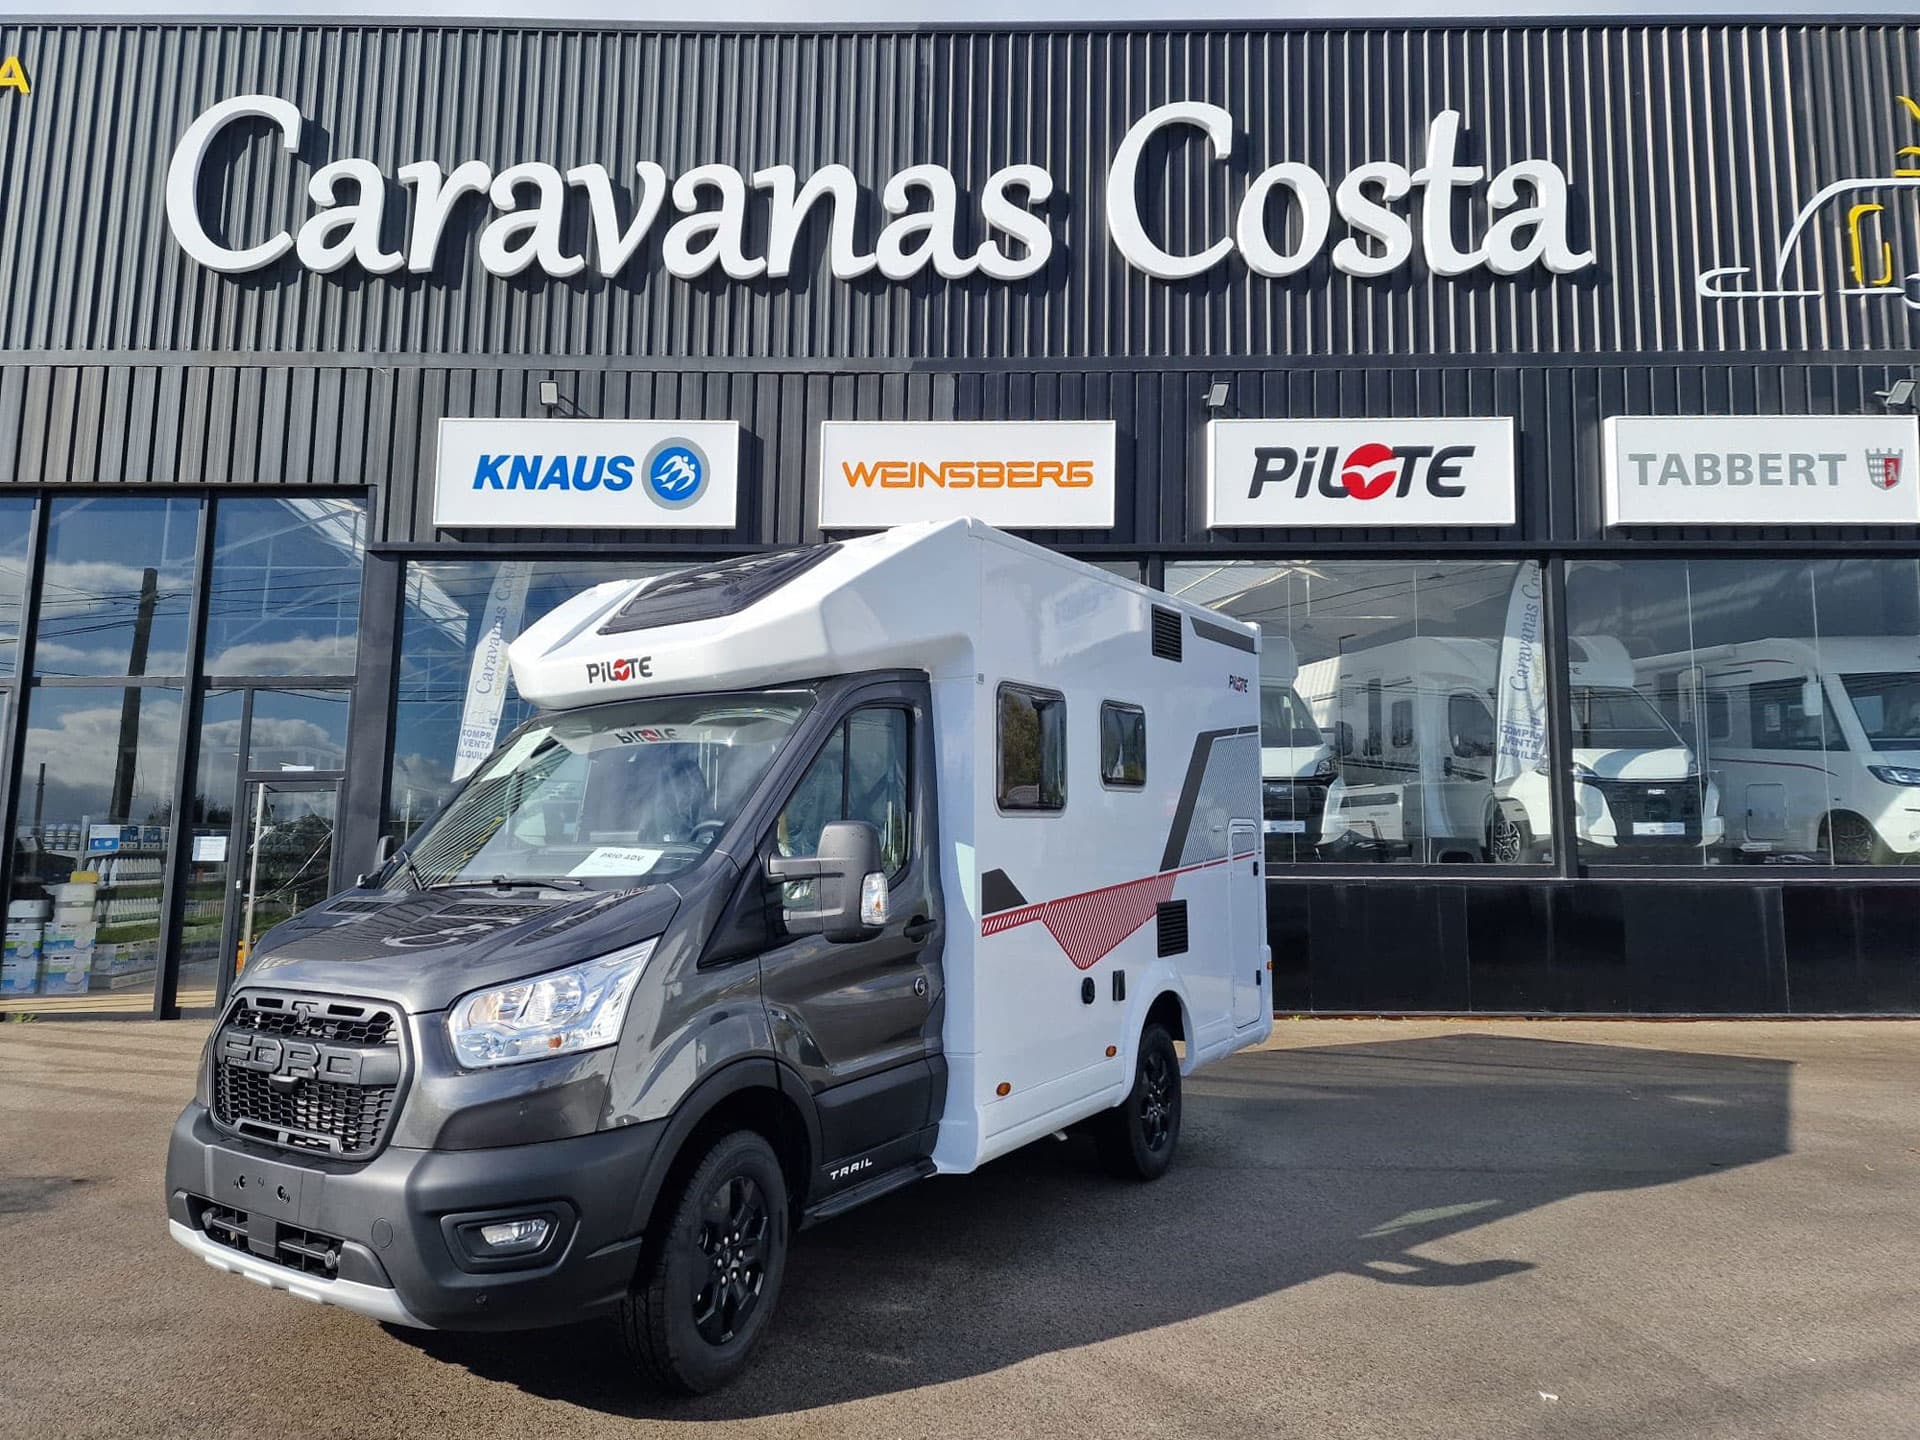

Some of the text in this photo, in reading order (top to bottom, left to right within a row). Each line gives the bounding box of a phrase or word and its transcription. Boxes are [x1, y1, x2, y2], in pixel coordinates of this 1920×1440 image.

[166, 93, 1595, 281] Caravanas Costa
[473, 454, 635, 490] KNAUS
[841, 460, 1095, 489] WEINSBERG
[1628, 452, 1848, 487] TABBERT
[1509, 602, 1540, 691] Caravanas
[217, 1031, 362, 1085] FORD
[830, 1158, 872, 1180] TRAIL
